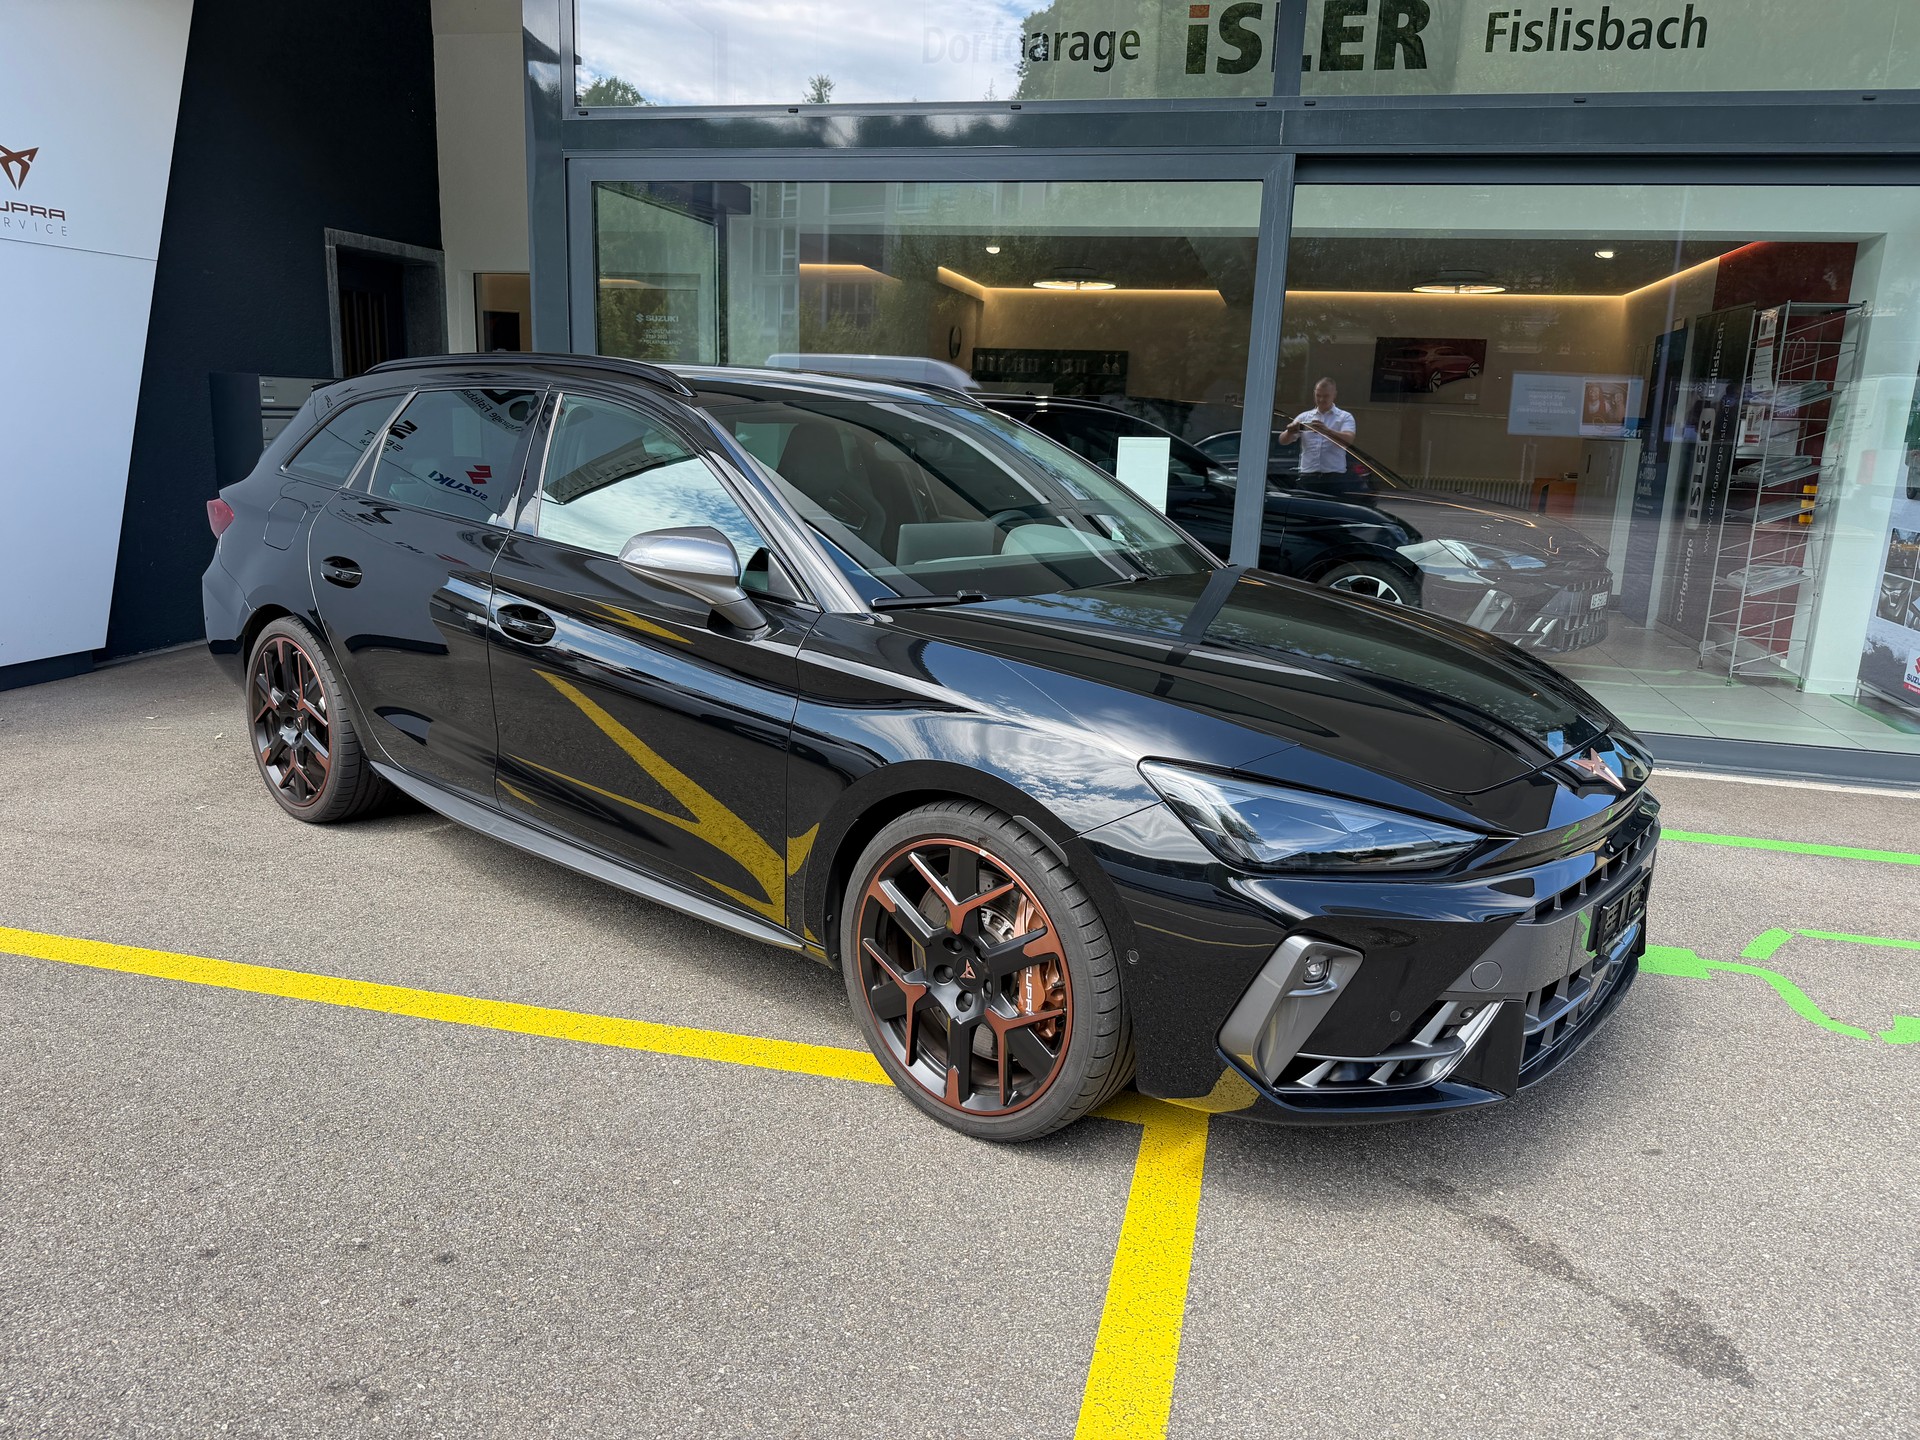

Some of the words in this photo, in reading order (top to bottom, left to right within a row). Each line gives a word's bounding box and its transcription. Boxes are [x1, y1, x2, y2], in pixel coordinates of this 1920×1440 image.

[1185, 0, 1431, 75] iSER
[1484, 4, 1708, 54] Fislisbach
[645, 314, 679, 322] SUZUKI
[1708, 321, 1725, 398] Fislisbach
[1676, 538, 1694, 623] Dorfgarage
